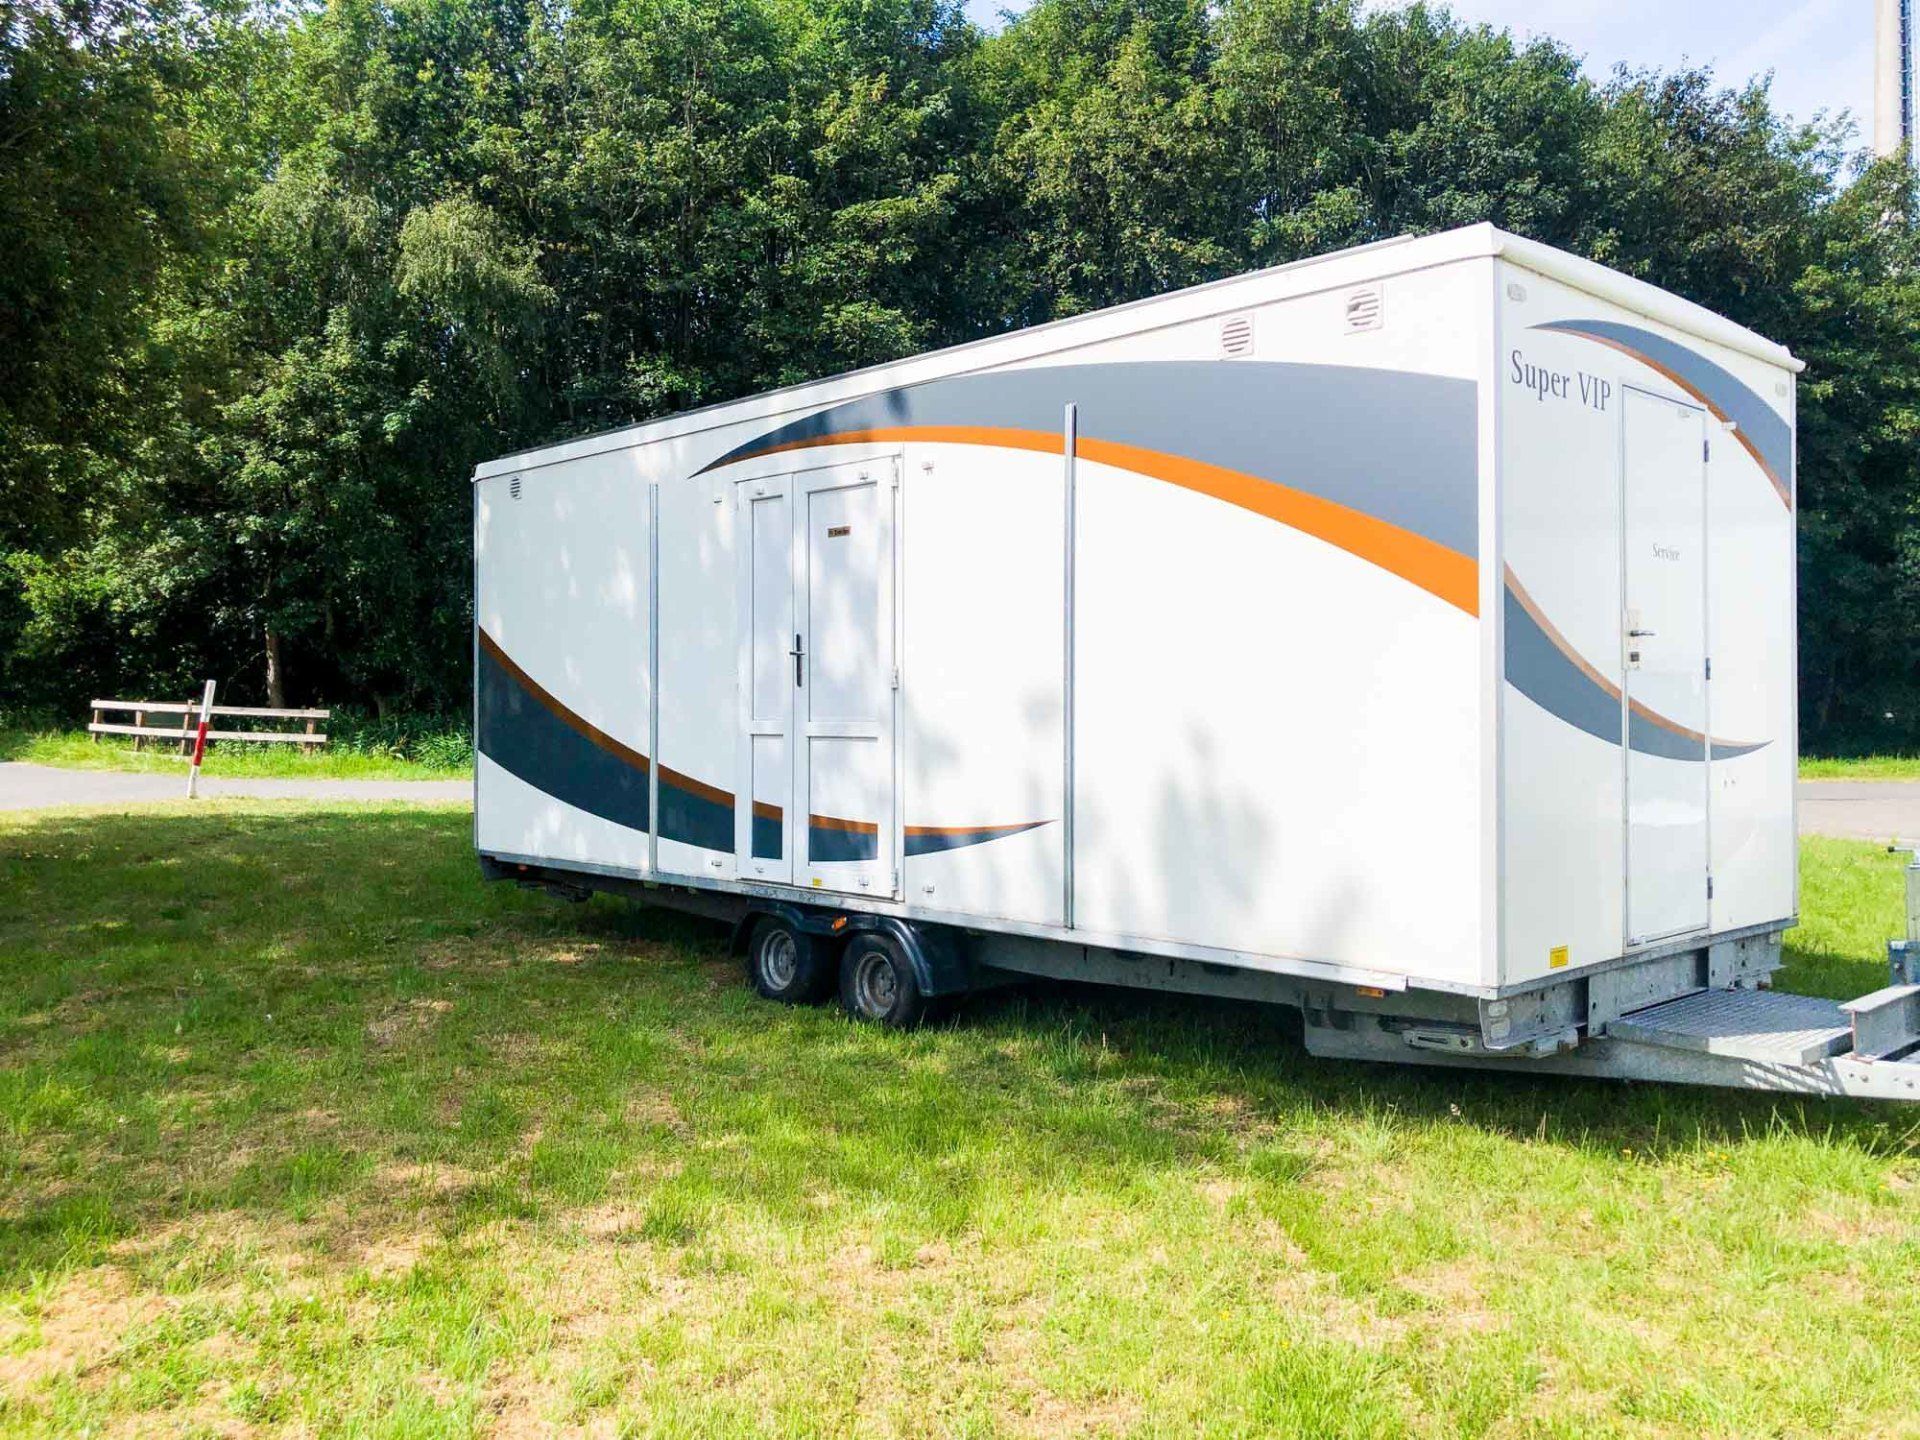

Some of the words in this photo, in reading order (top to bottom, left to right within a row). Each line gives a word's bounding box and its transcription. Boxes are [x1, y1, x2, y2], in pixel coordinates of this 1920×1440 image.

[1511, 349, 1570, 401] Super
[1577, 371, 1611, 411] VIP
[1652, 542, 1680, 561] Service
